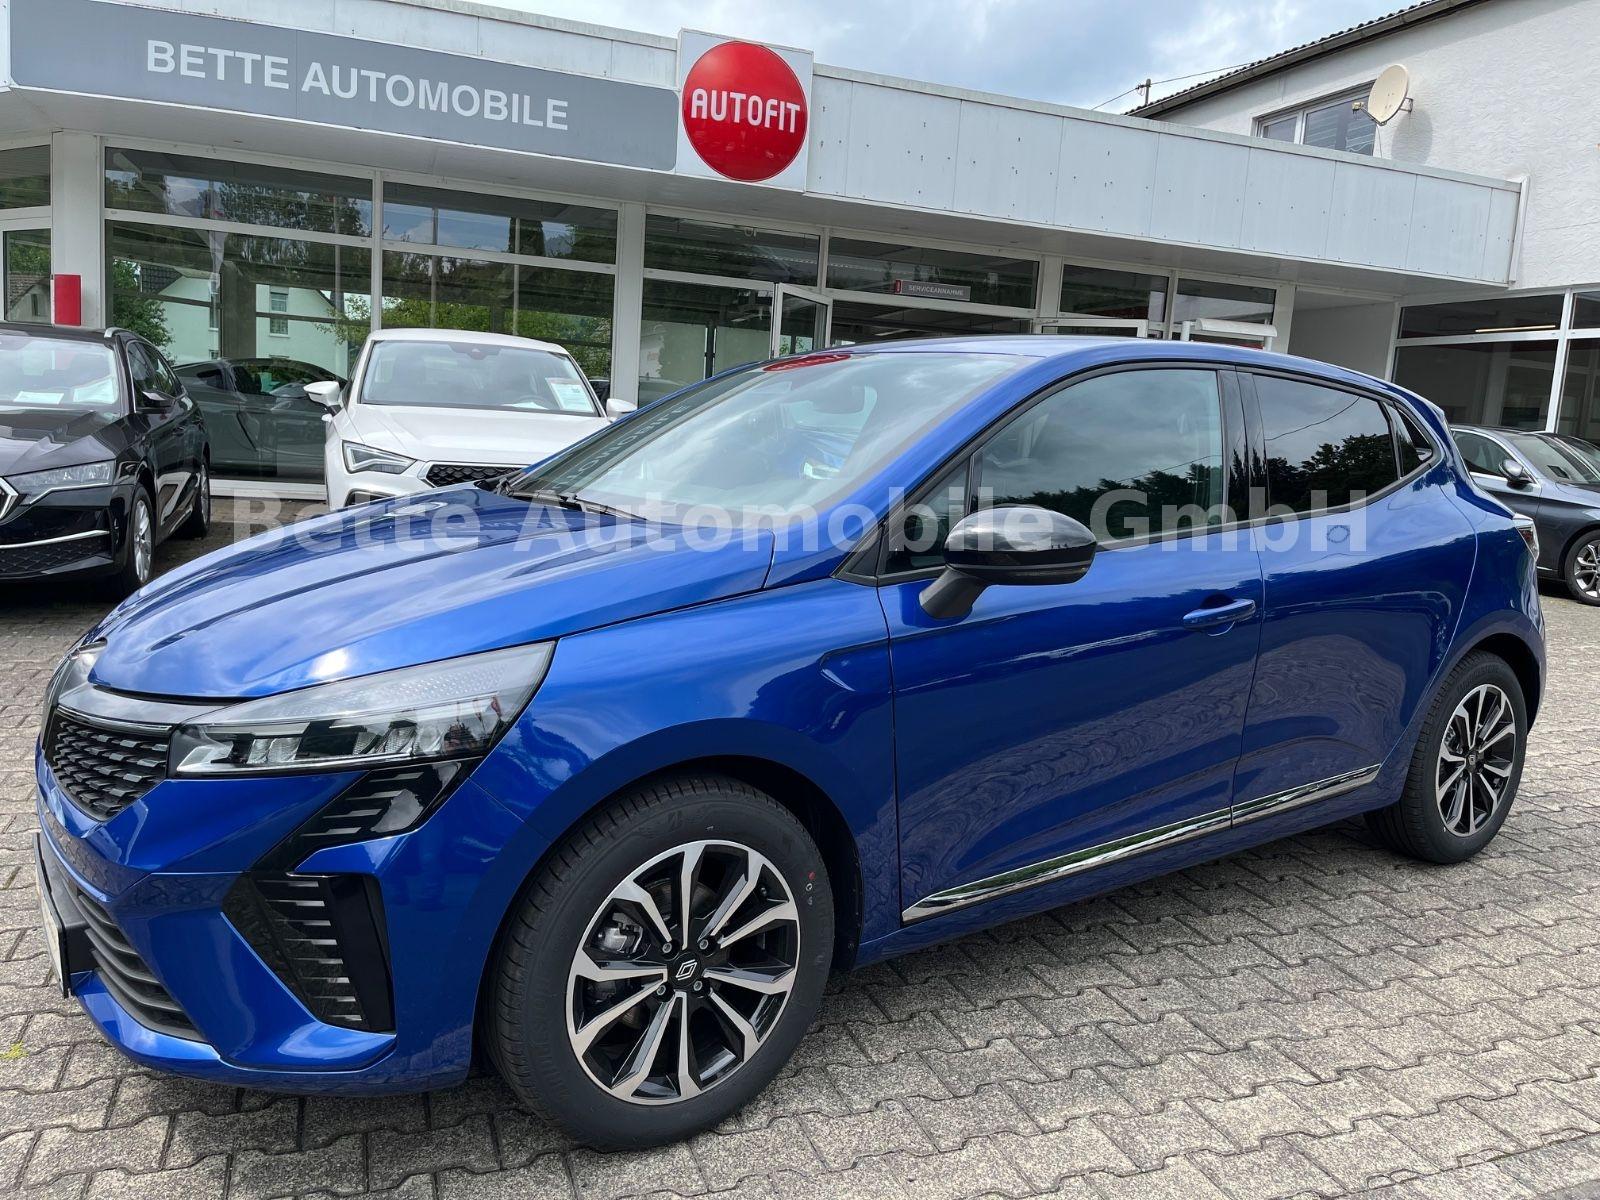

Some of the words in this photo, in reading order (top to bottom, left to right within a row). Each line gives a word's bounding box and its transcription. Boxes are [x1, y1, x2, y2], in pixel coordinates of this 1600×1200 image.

[147, 39, 290, 89] BETTE
[301, 61, 568, 130] AUTOMOBILE
[691, 88, 801, 133] AUTOFIT
[909, 284, 964, 297] SERVICEANNAHME
